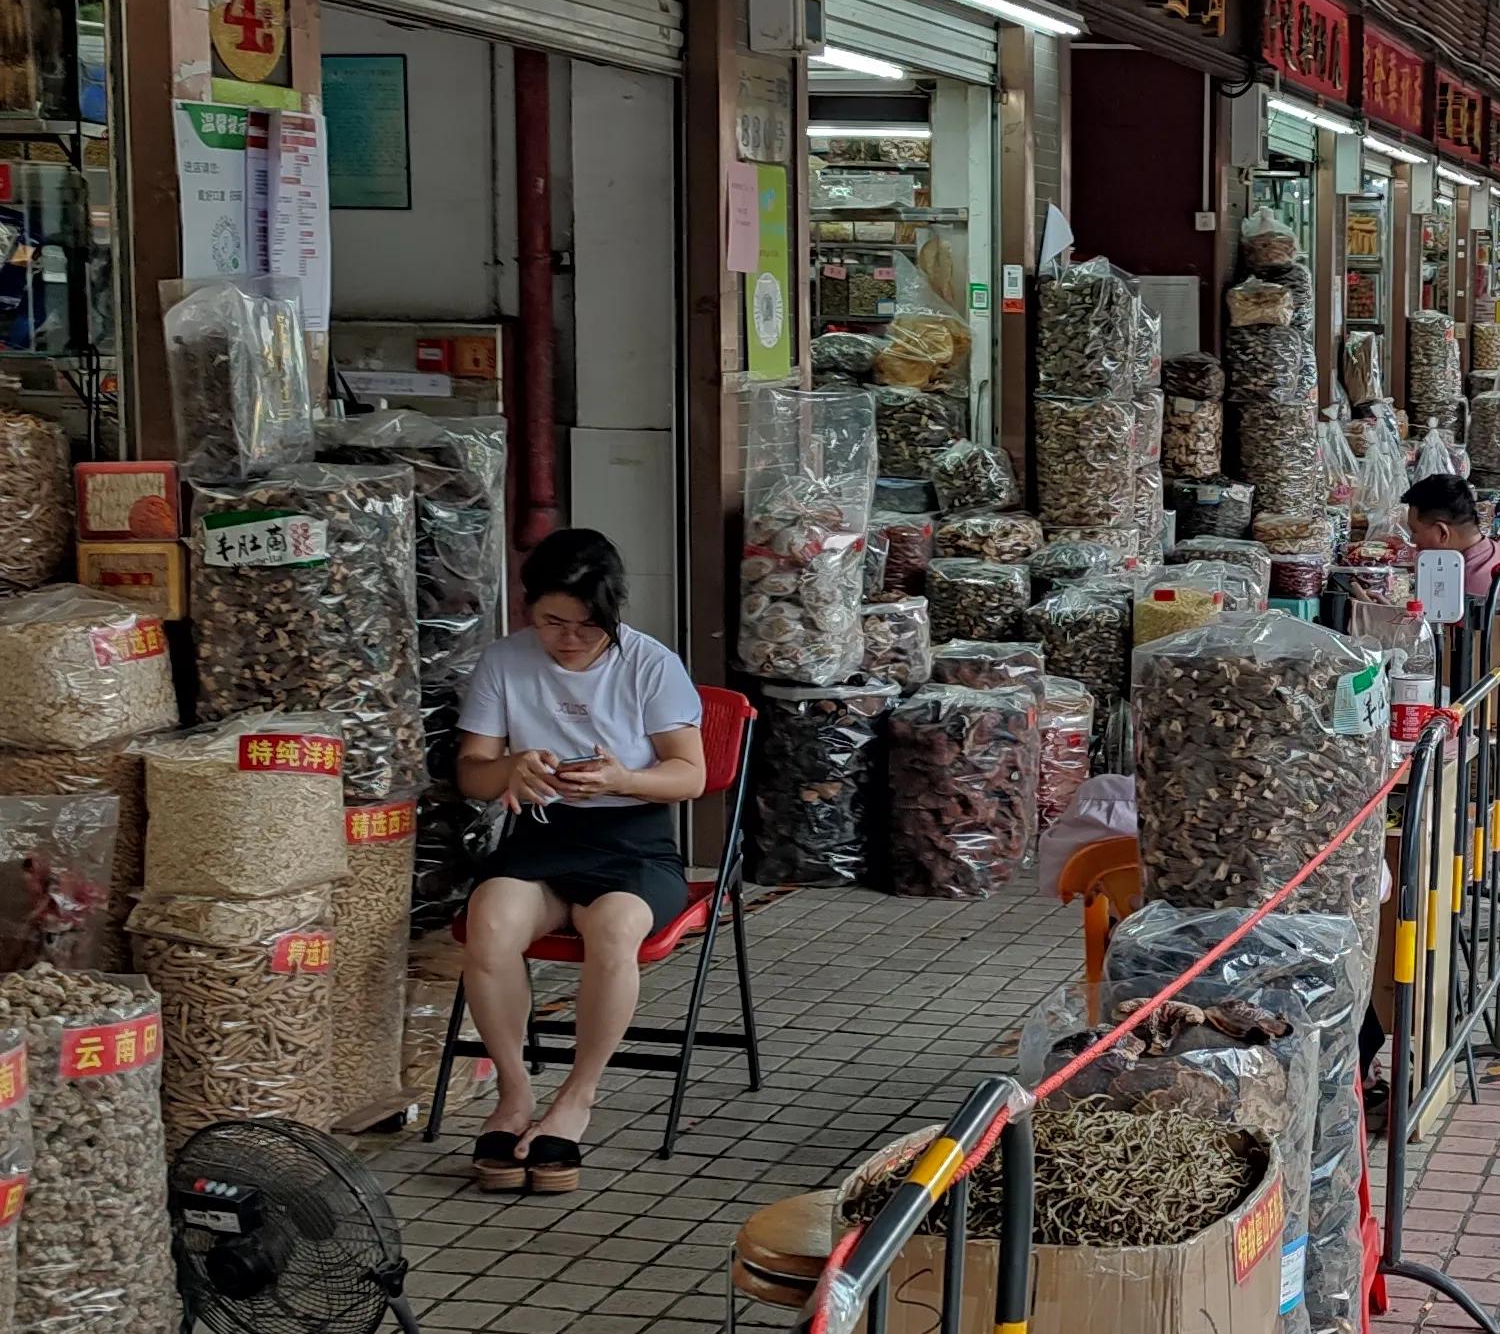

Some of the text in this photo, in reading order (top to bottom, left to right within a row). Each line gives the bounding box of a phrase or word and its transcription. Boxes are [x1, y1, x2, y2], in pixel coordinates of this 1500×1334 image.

[216, 523, 287, 562] 羊肚菌
[75, 1023, 158, 1070] 云南田
